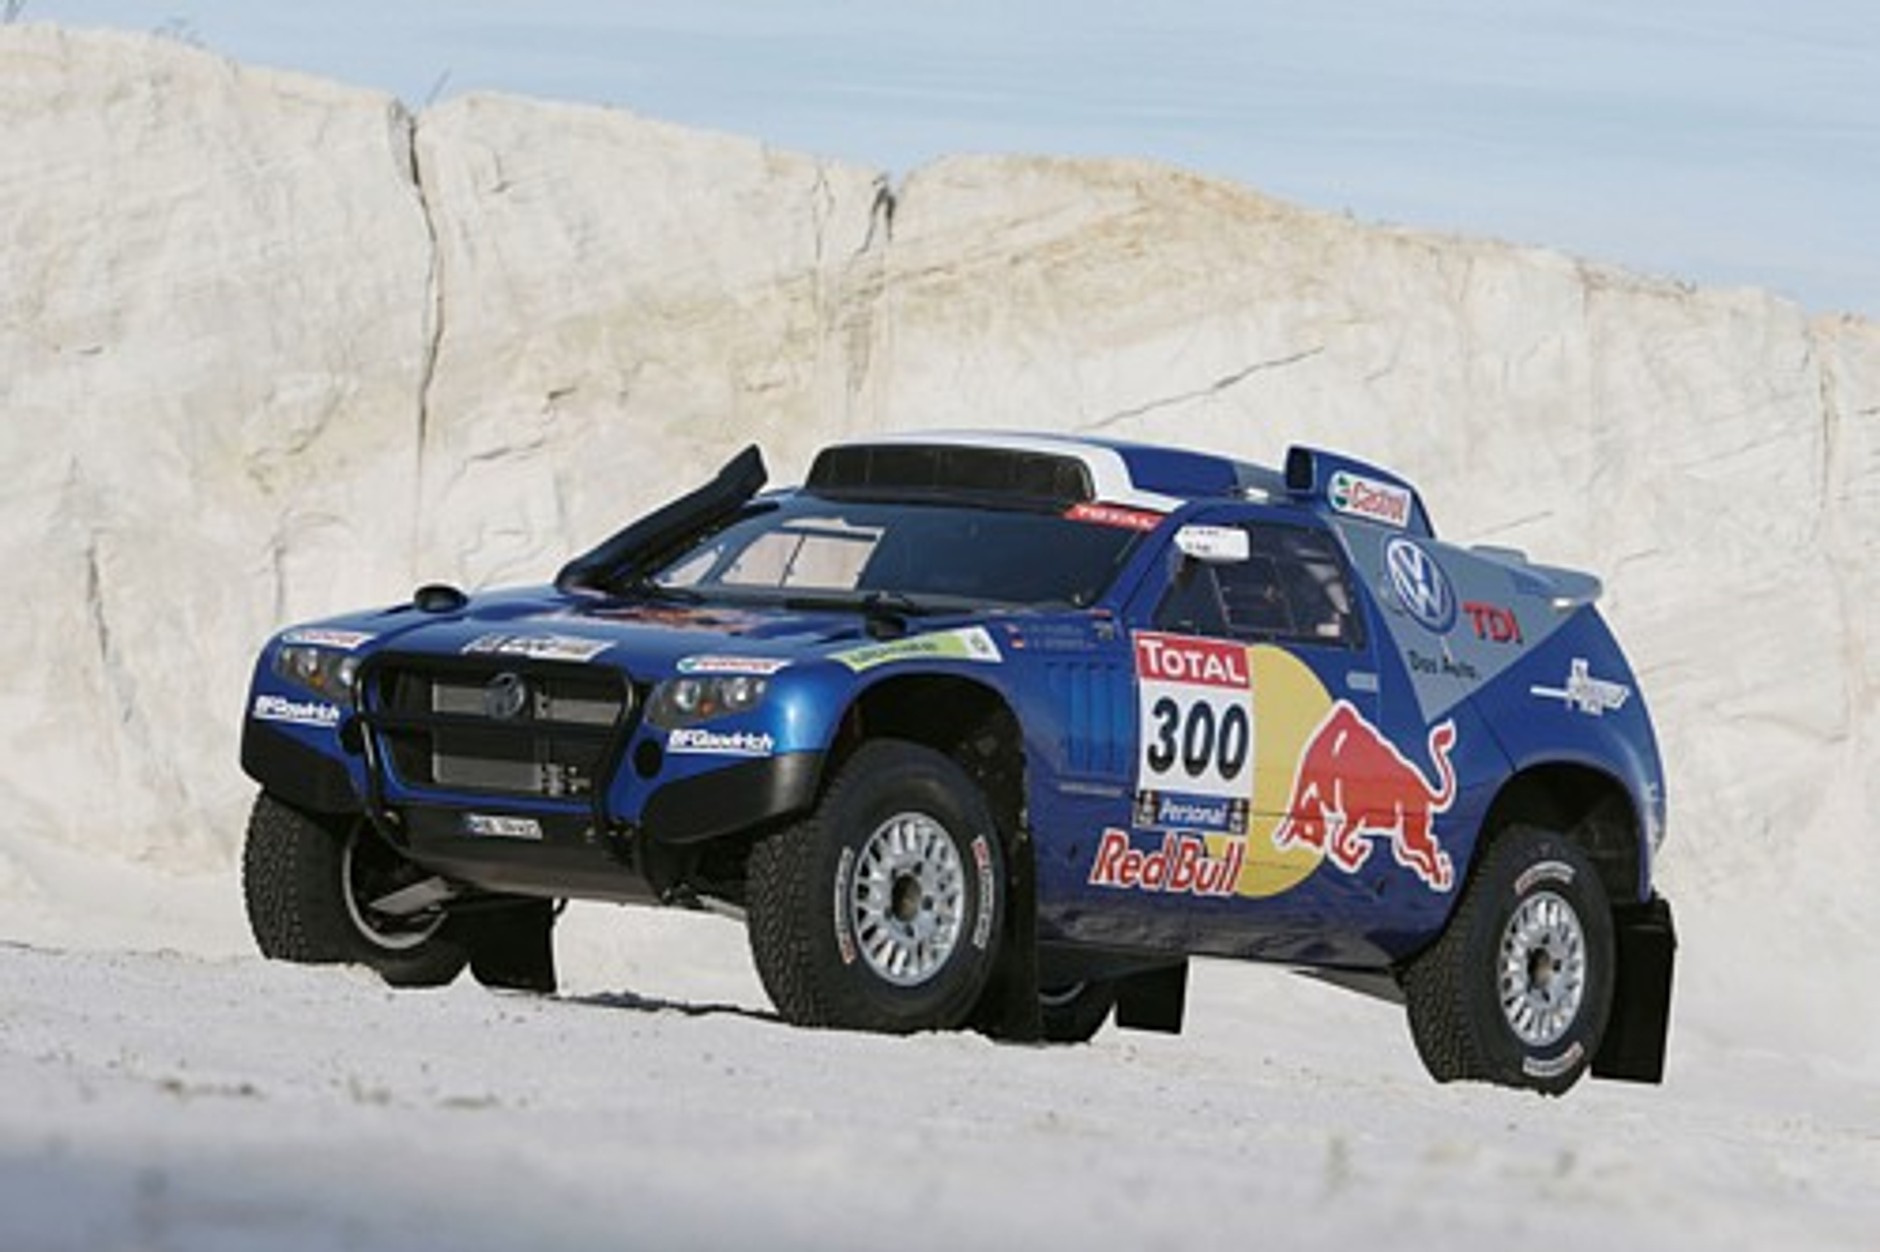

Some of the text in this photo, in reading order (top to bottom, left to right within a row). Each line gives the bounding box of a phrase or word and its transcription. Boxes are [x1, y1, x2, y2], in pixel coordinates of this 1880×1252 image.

[1463, 601, 1522, 643] TDI
[1138, 639, 1247, 684] TOTAL
[1147, 696, 1249, 781] 300
[1159, 799, 1229, 826] Personal
[1090, 828, 1246, 897] Red Bull
